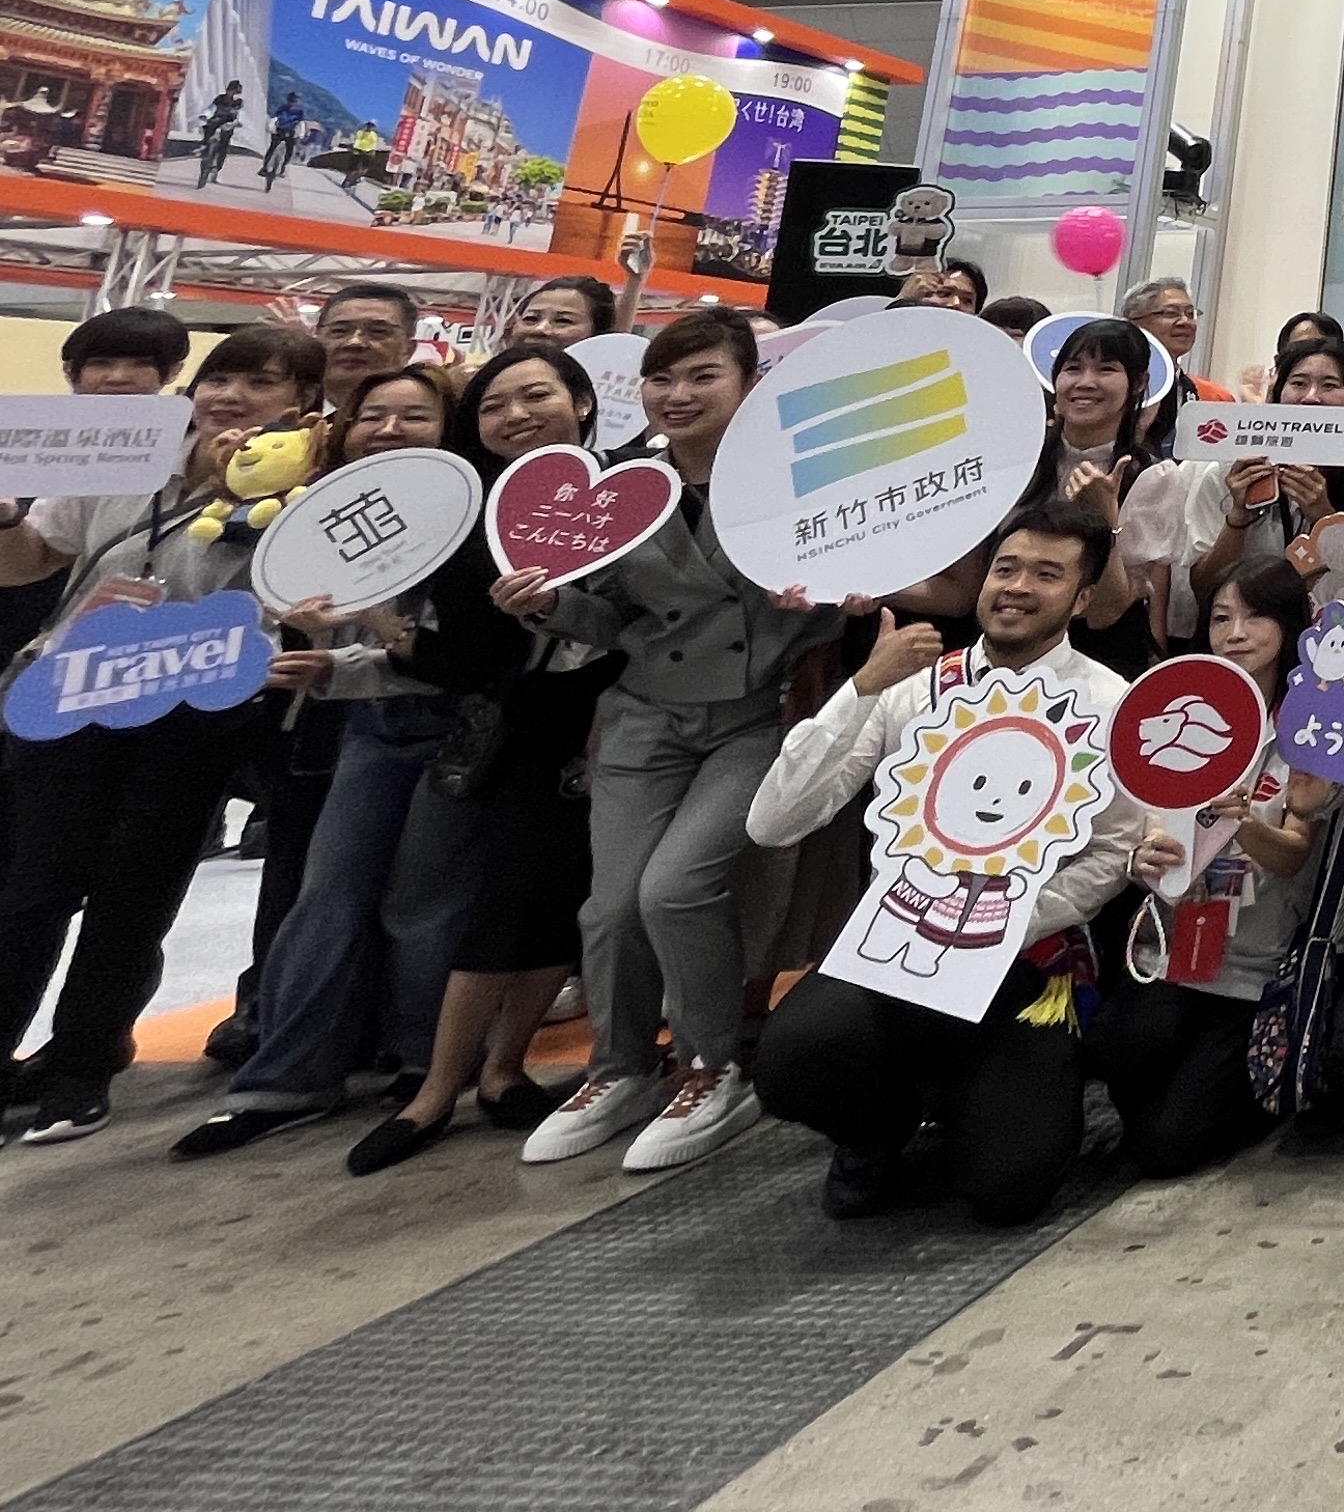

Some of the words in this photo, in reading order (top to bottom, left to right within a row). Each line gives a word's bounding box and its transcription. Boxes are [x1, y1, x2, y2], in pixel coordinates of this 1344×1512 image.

[345, 37, 396, 61] WAVES
[399, 52, 421, 68] OF
[422, 57, 485, 81] WONDER
[644, 47, 691, 75] 17:00
[773, 72, 813, 93] 19:00
[831, 214, 885, 226] TAIPEI
[818, 226, 889, 257] 台北
[1237, 419, 1277, 432] LION
[1281, 421, 1344, 434] TRAVEL
[793, 454, 984, 547] 新竹市政府
[508, 523, 610, 553] こんにちは
[796, 531, 866, 562] HSINCHU
[872, 518, 901, 536] City
[905, 485, 988, 523] Government
[56, 624, 246, 698] Travel
